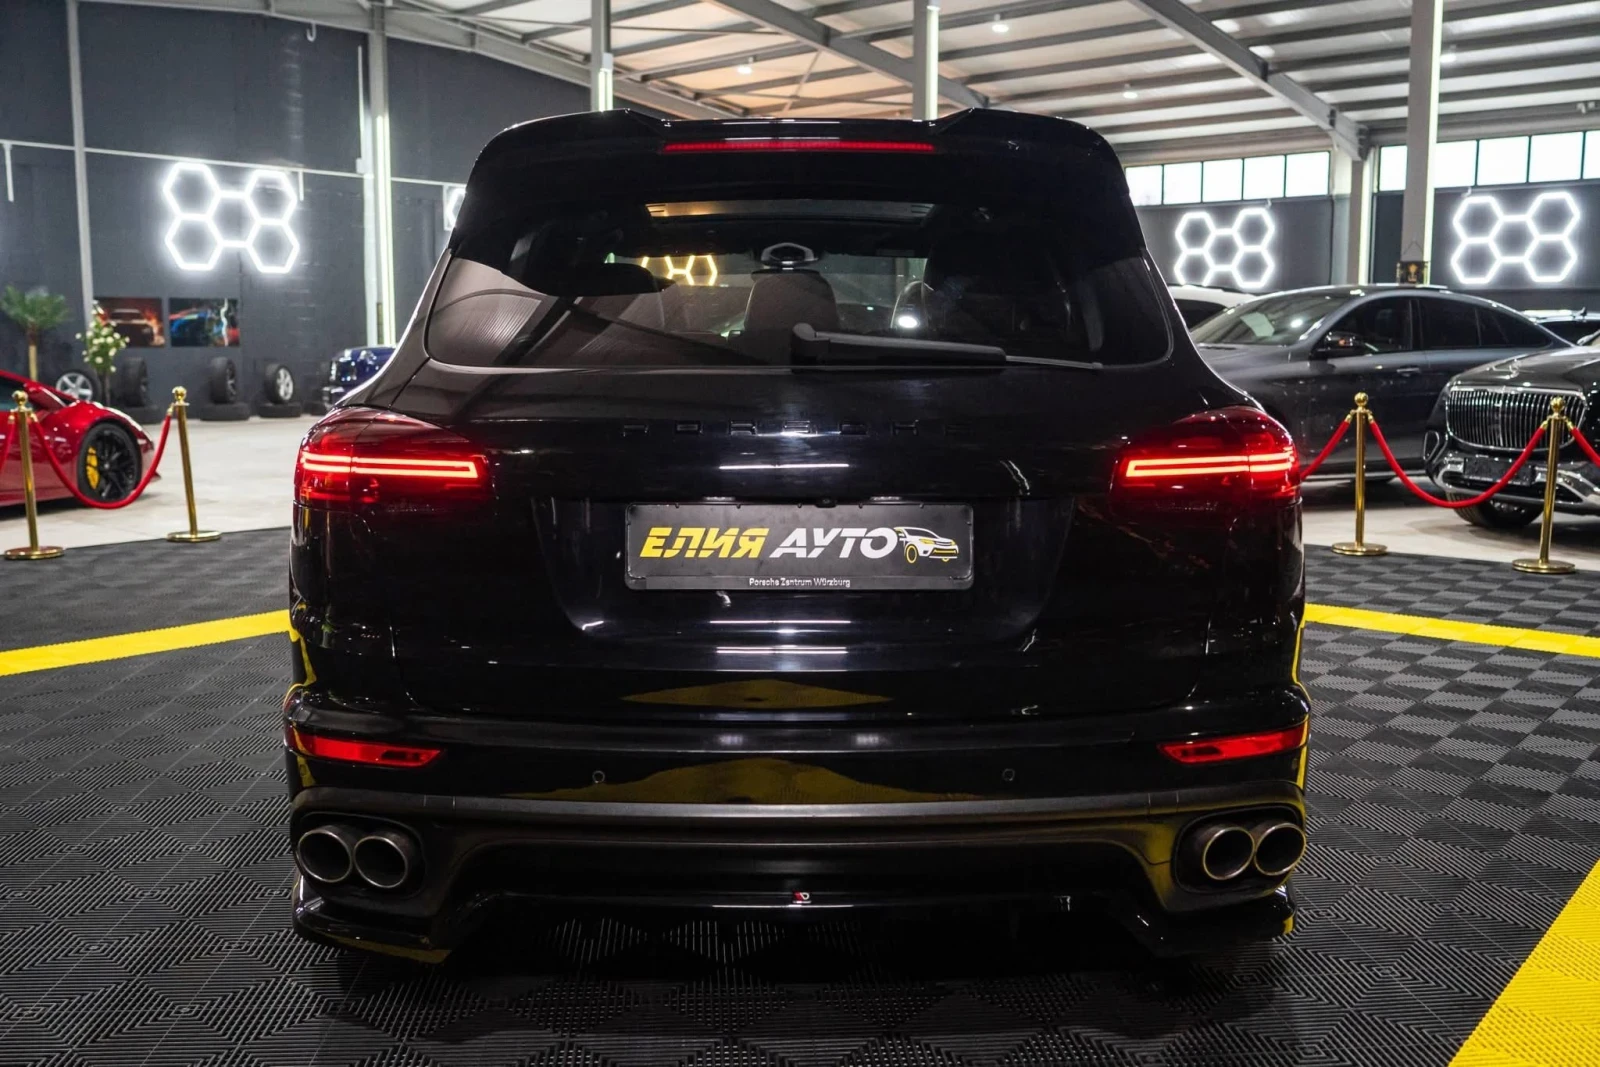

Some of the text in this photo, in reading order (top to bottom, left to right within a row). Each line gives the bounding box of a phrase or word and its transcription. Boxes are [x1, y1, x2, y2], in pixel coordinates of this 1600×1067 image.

[640, 527, 898, 559] ЕЛИЯ АУТО
[749, 577, 850, 588] Porsche Zentrum Würzburg
